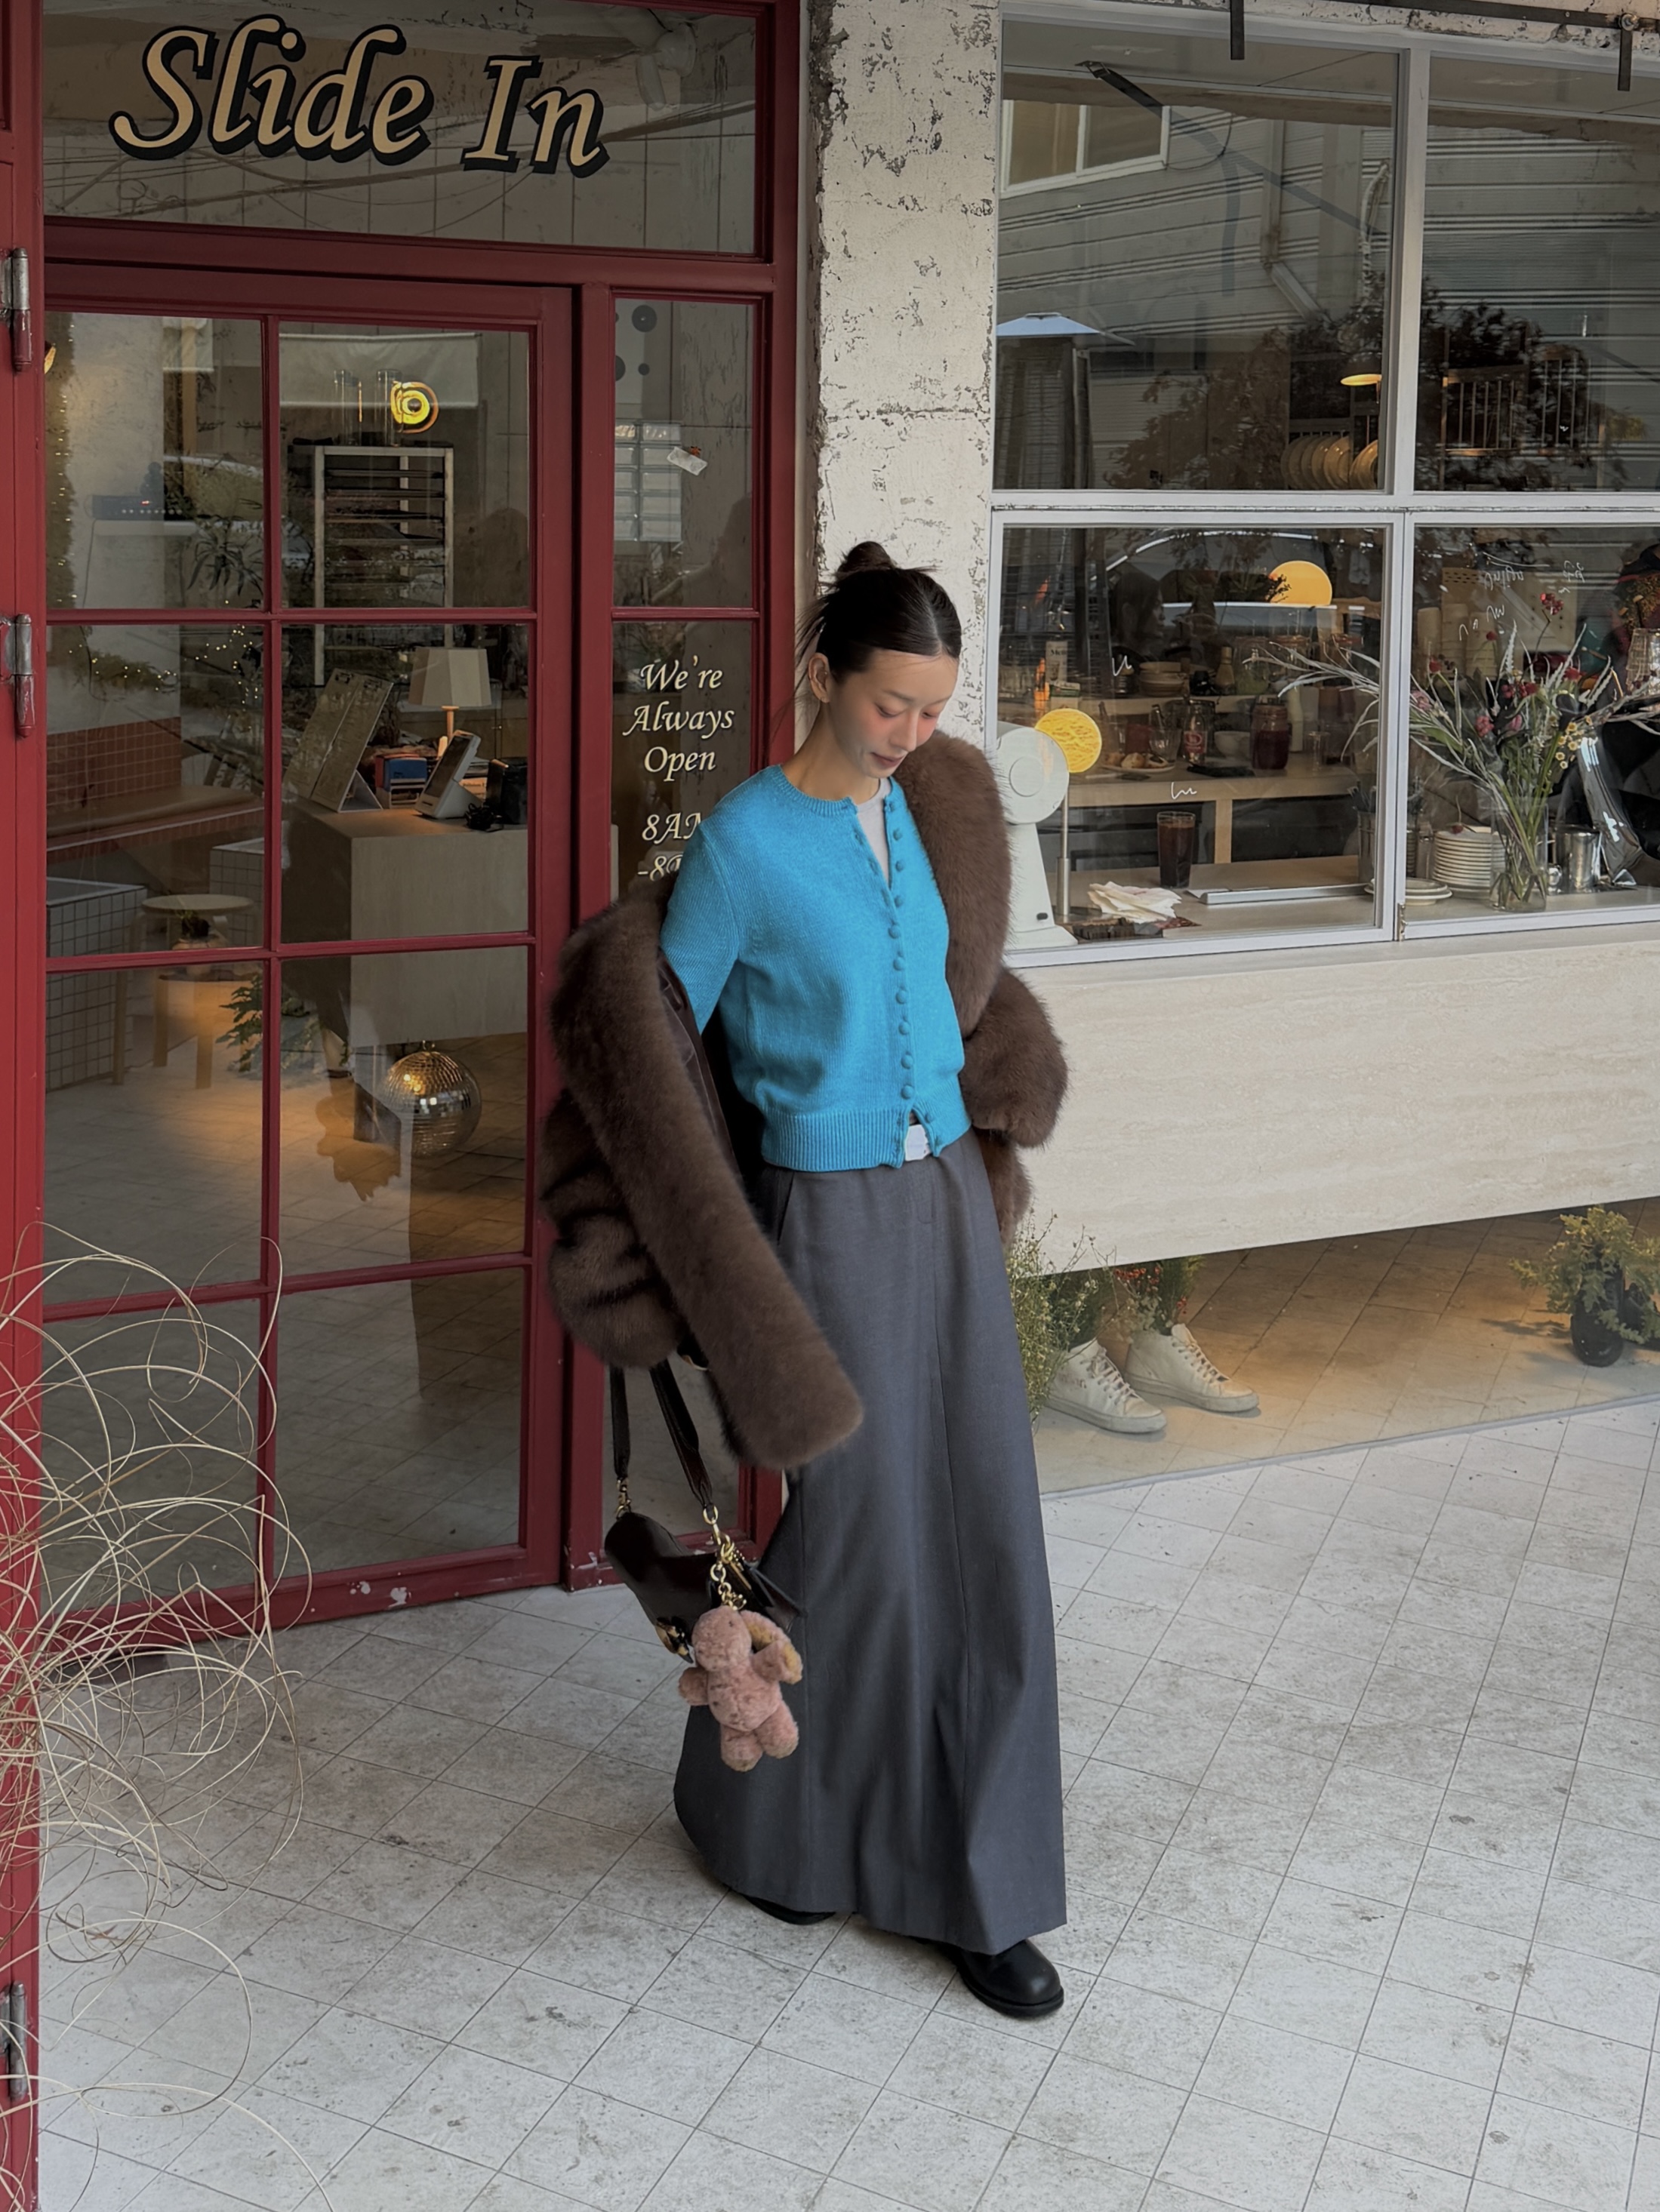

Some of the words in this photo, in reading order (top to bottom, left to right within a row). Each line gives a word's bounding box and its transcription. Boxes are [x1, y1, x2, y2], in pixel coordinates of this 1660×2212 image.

[110, 14, 433, 162] Slide
[461, 55, 610, 177] In
[639, 654, 723, 691] We're
[622, 700, 735, 740] Always
[643, 746, 716, 782] Open
